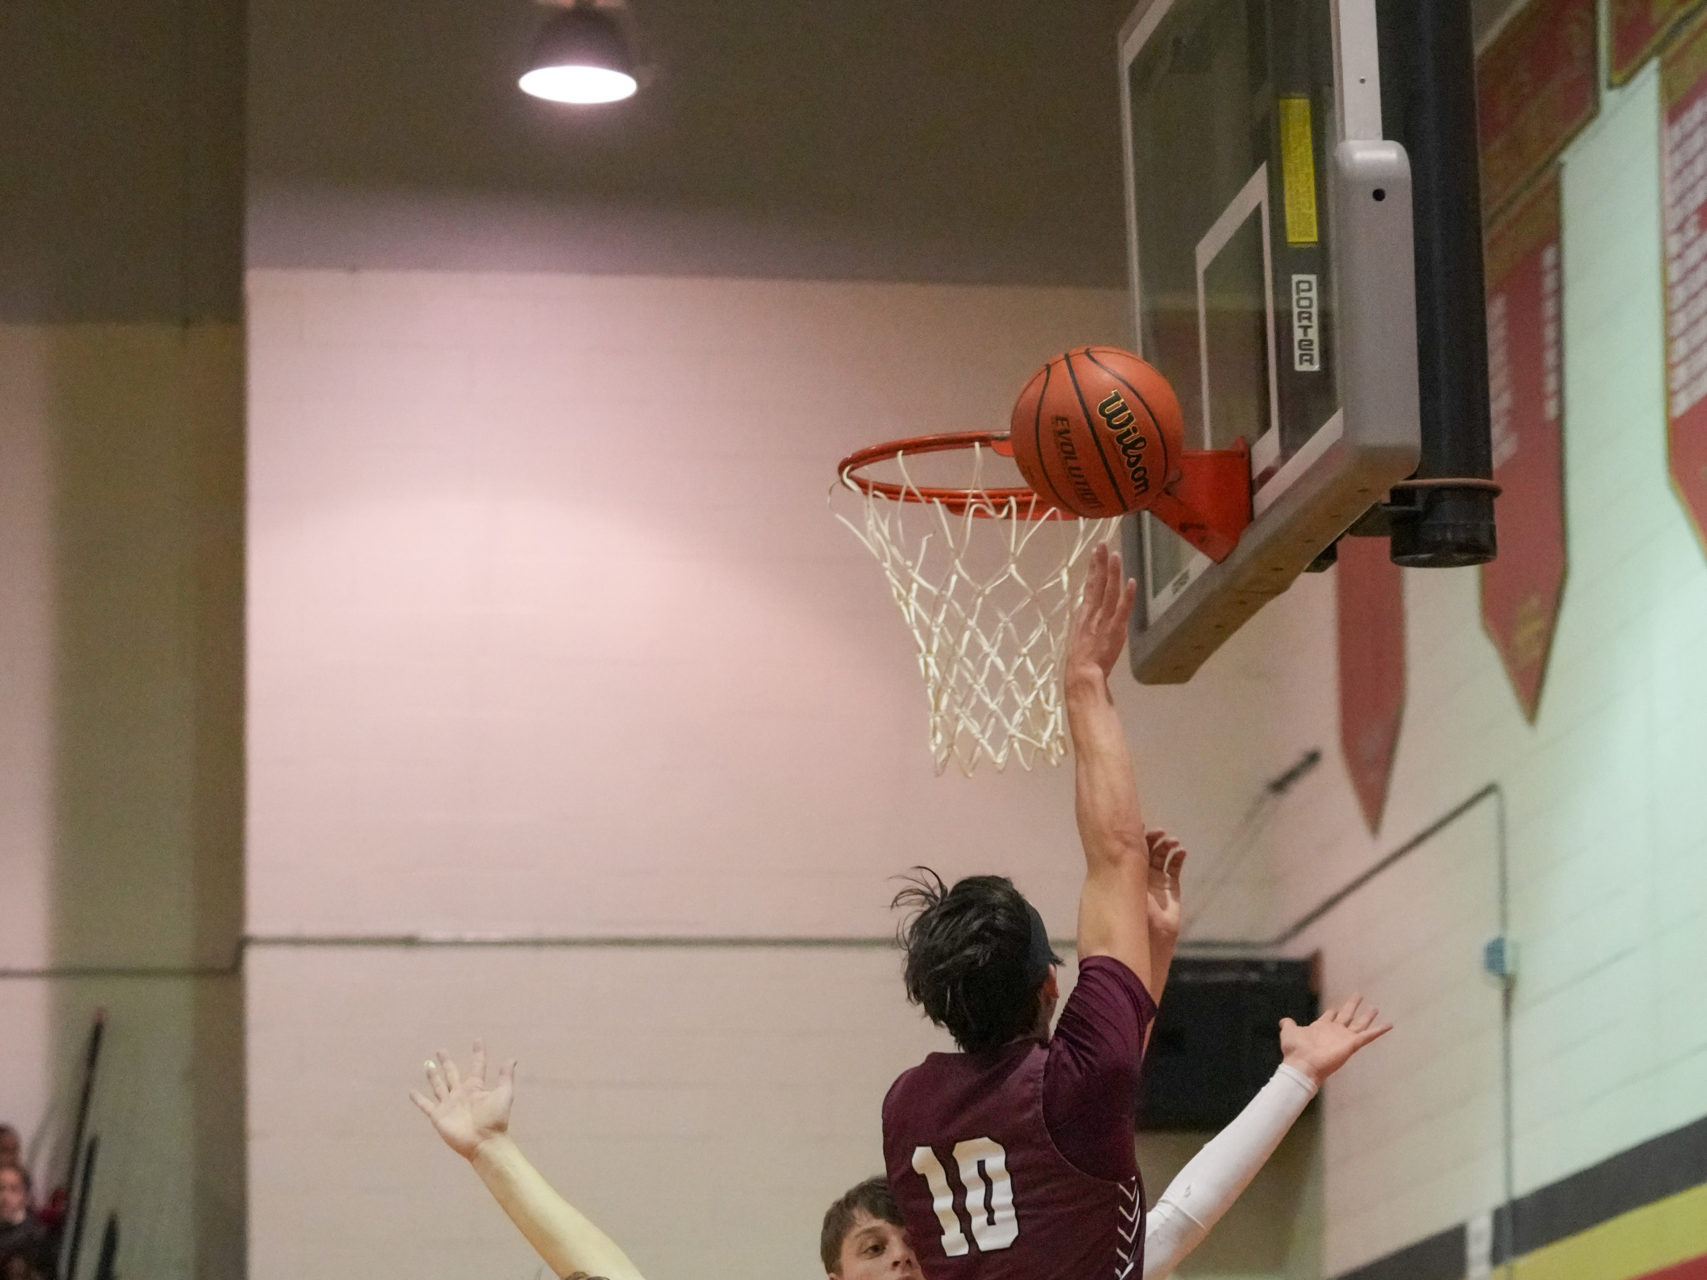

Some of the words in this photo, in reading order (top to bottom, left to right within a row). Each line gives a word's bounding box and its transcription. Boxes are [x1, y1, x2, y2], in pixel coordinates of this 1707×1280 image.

[1296, 280, 1314, 366] PORTER
[1097, 389, 1149, 497] Wilson
[911, 1136, 1020, 1258] 10
